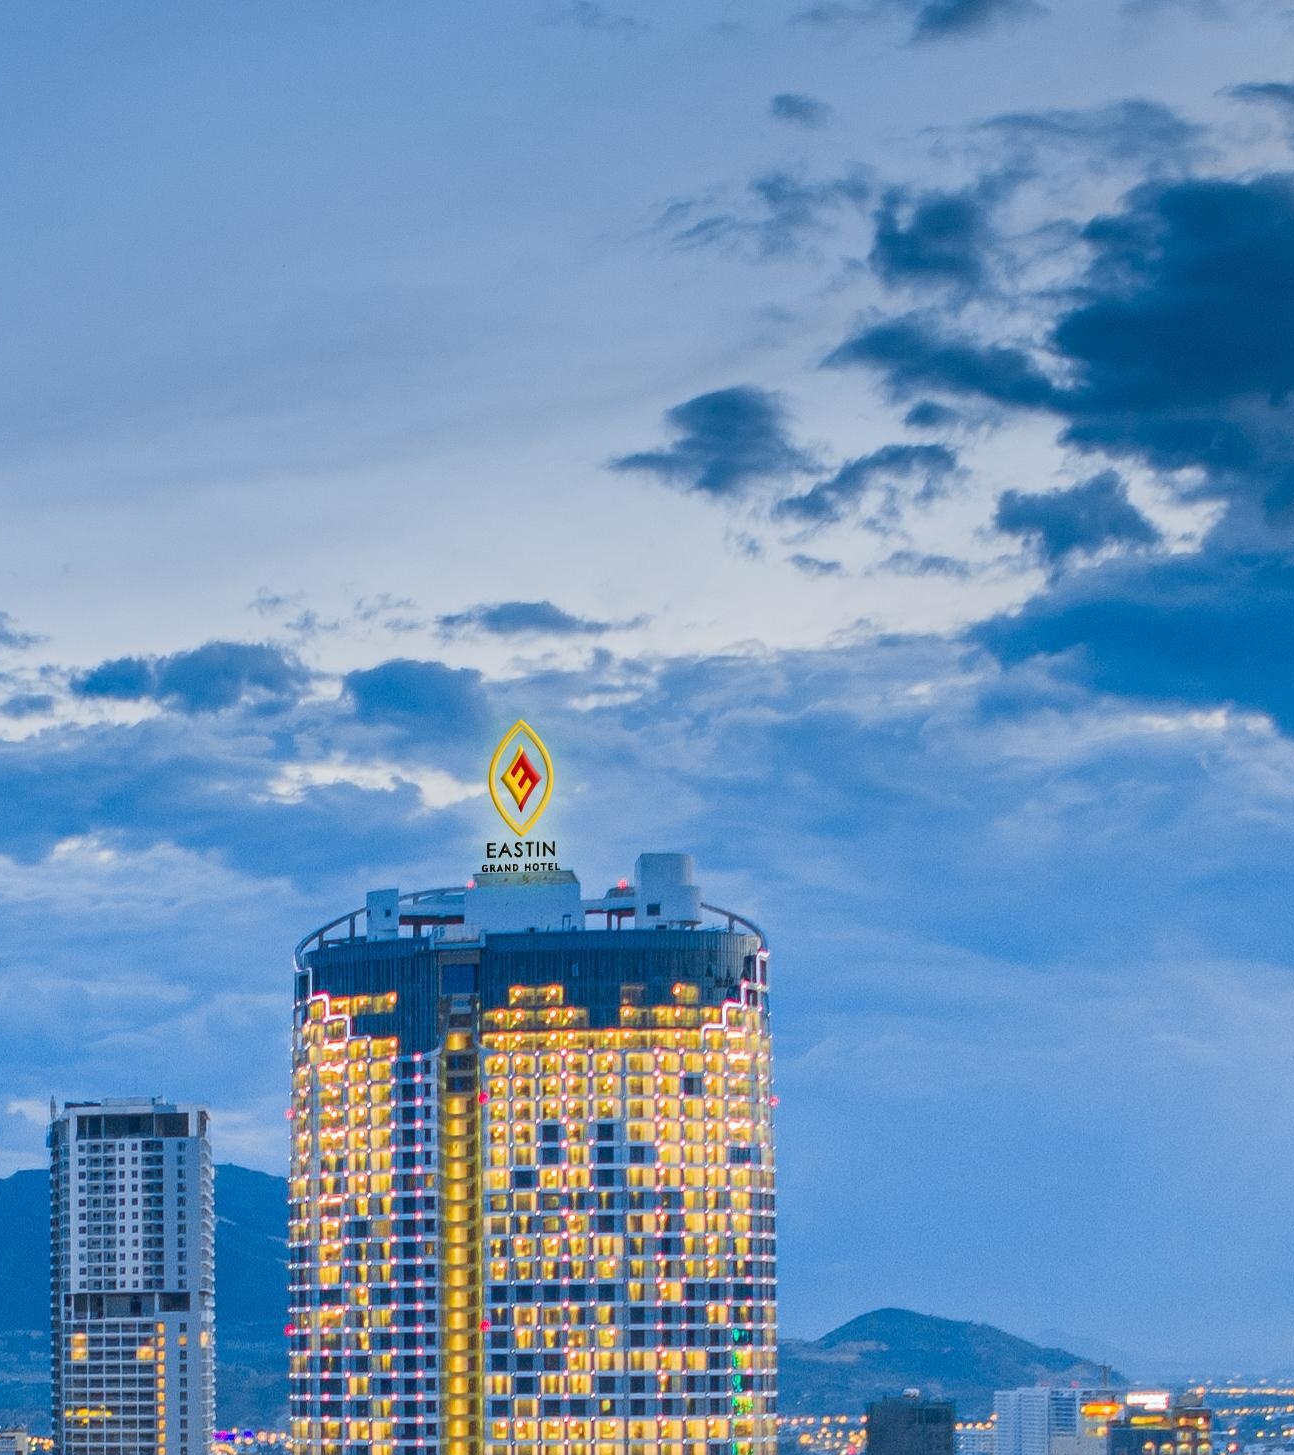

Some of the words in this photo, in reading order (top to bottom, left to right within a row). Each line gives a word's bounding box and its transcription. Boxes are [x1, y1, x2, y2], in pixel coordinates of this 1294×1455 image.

[486, 841, 556, 859] EASTIN
[481, 863, 519, 873] GRAND
[524, 862, 561, 872] HOTEL
